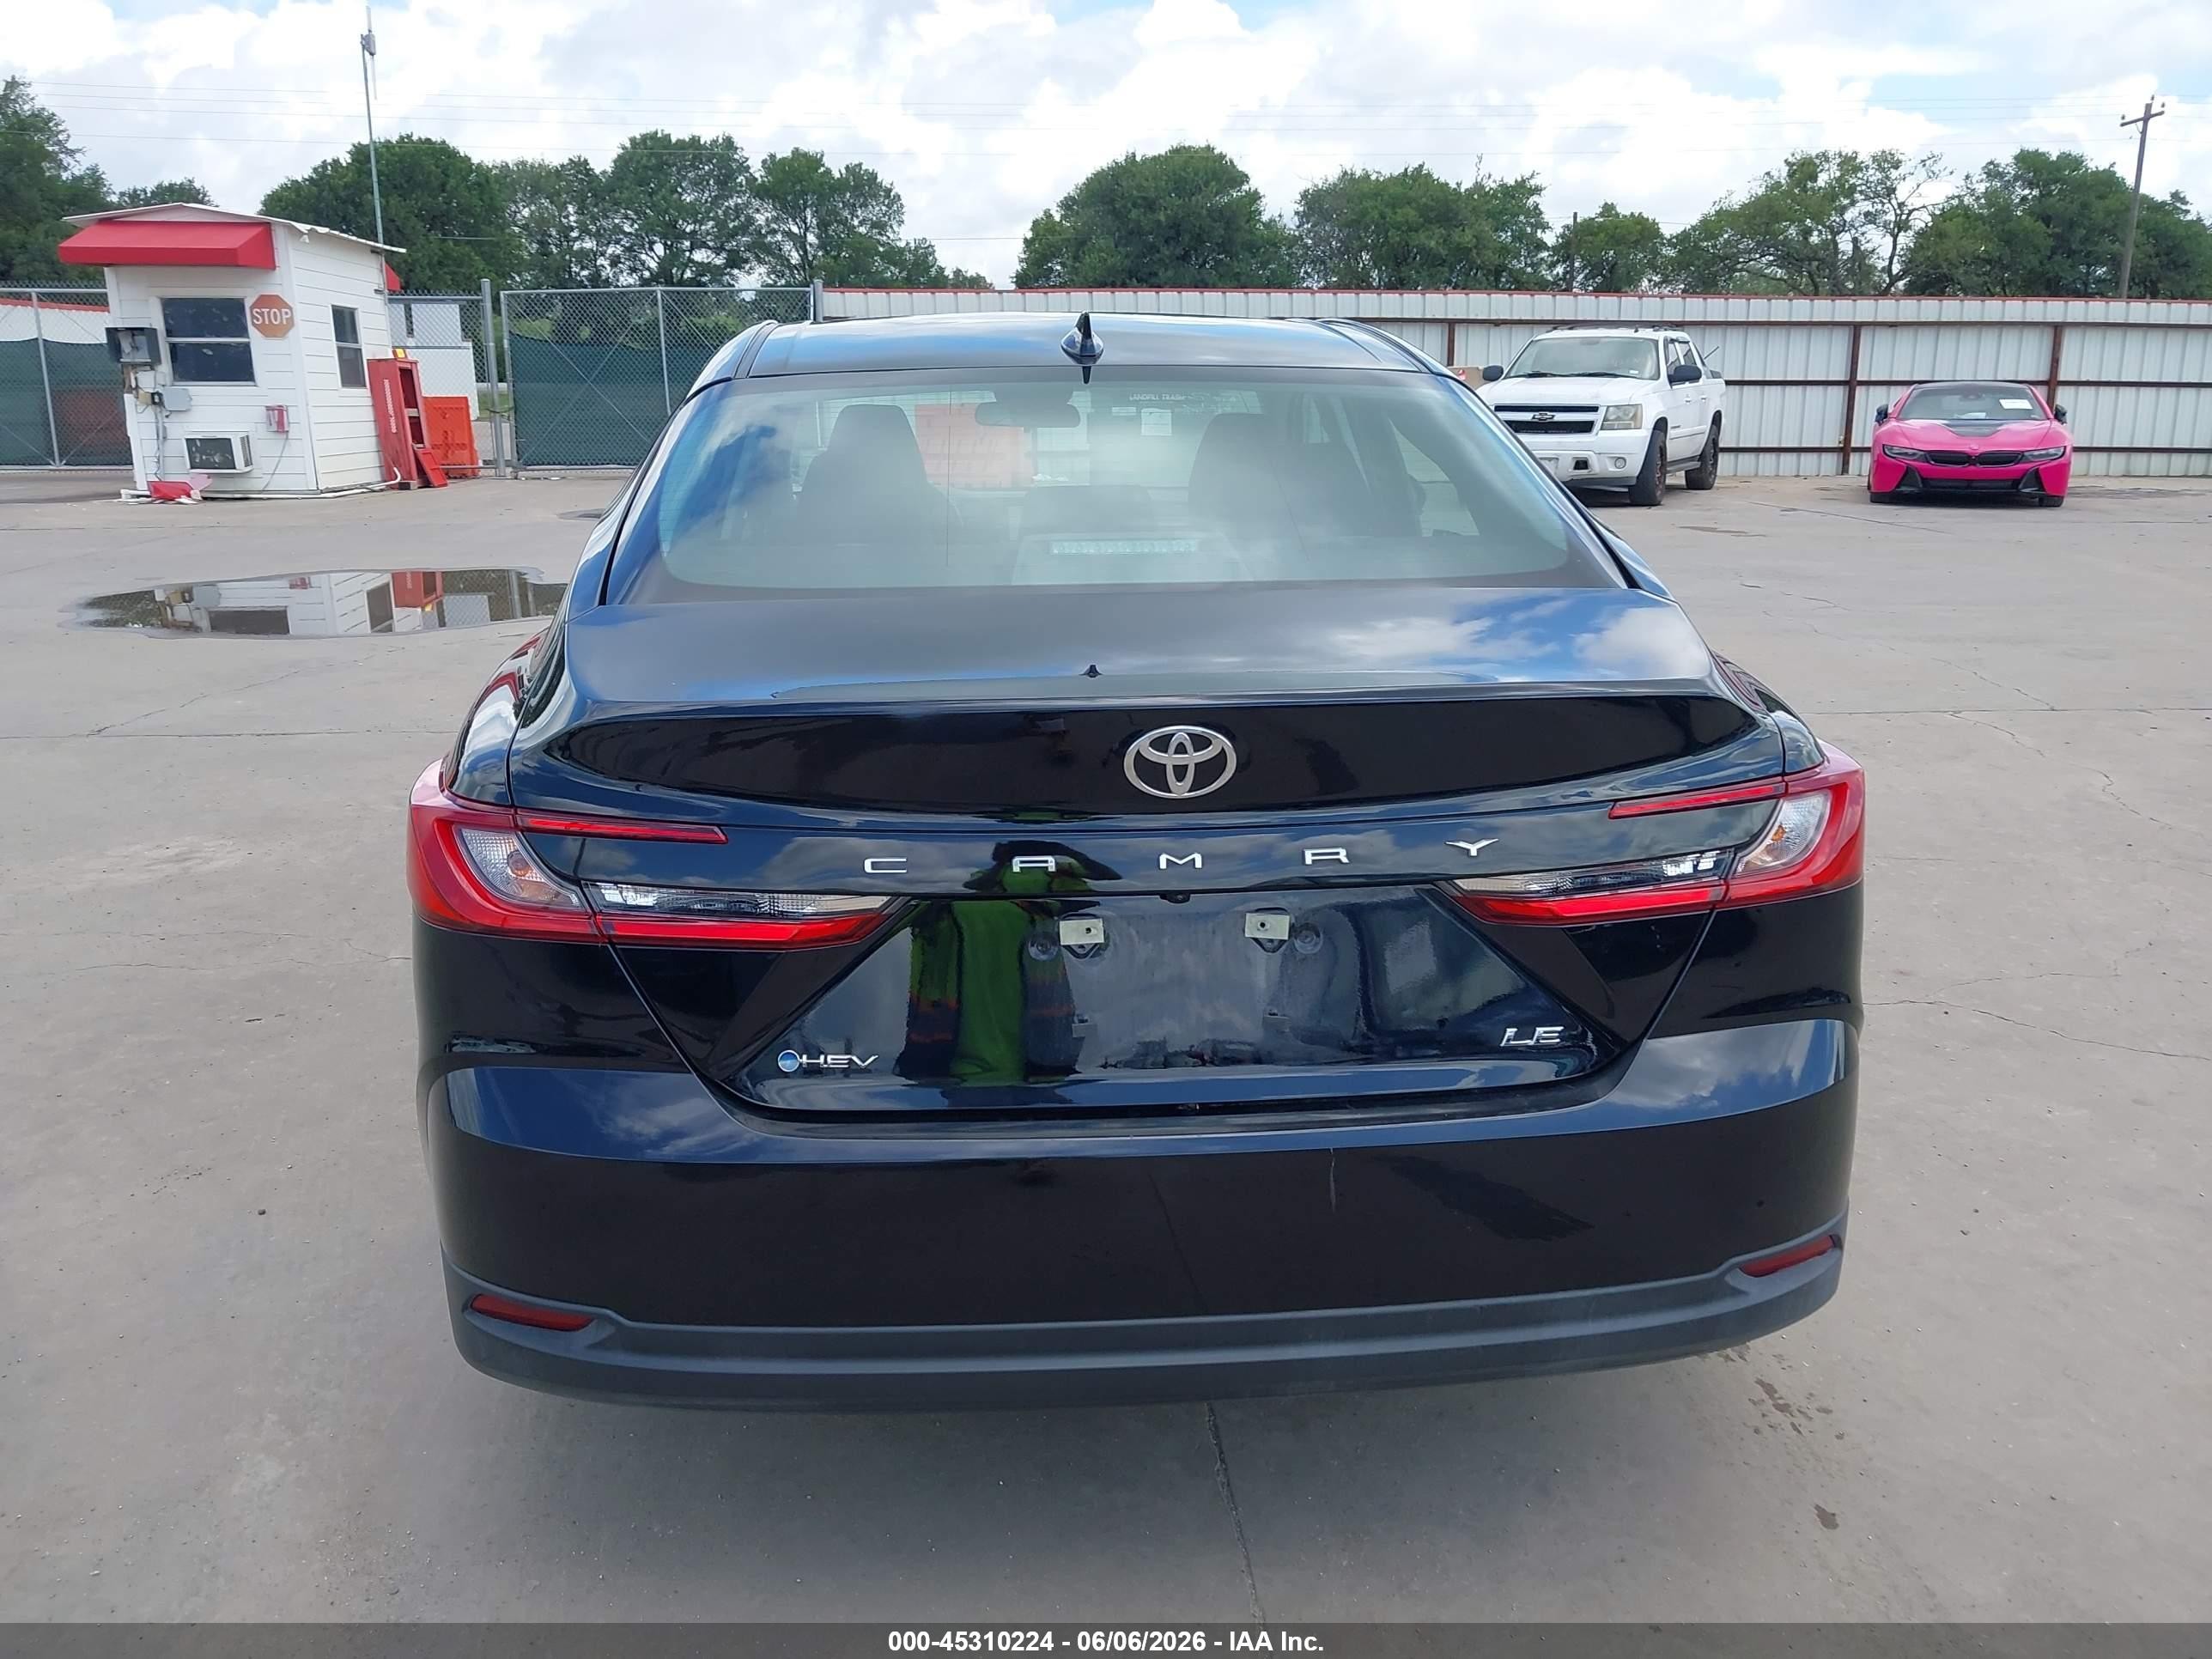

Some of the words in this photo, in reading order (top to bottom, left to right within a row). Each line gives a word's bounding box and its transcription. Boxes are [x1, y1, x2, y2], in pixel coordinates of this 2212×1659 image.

[252, 308, 292, 325] STOP
[863, 838, 1499, 875] CAMRY
[1500, 1026, 1565, 1047] LE
[802, 1054, 879, 1068] HEV
